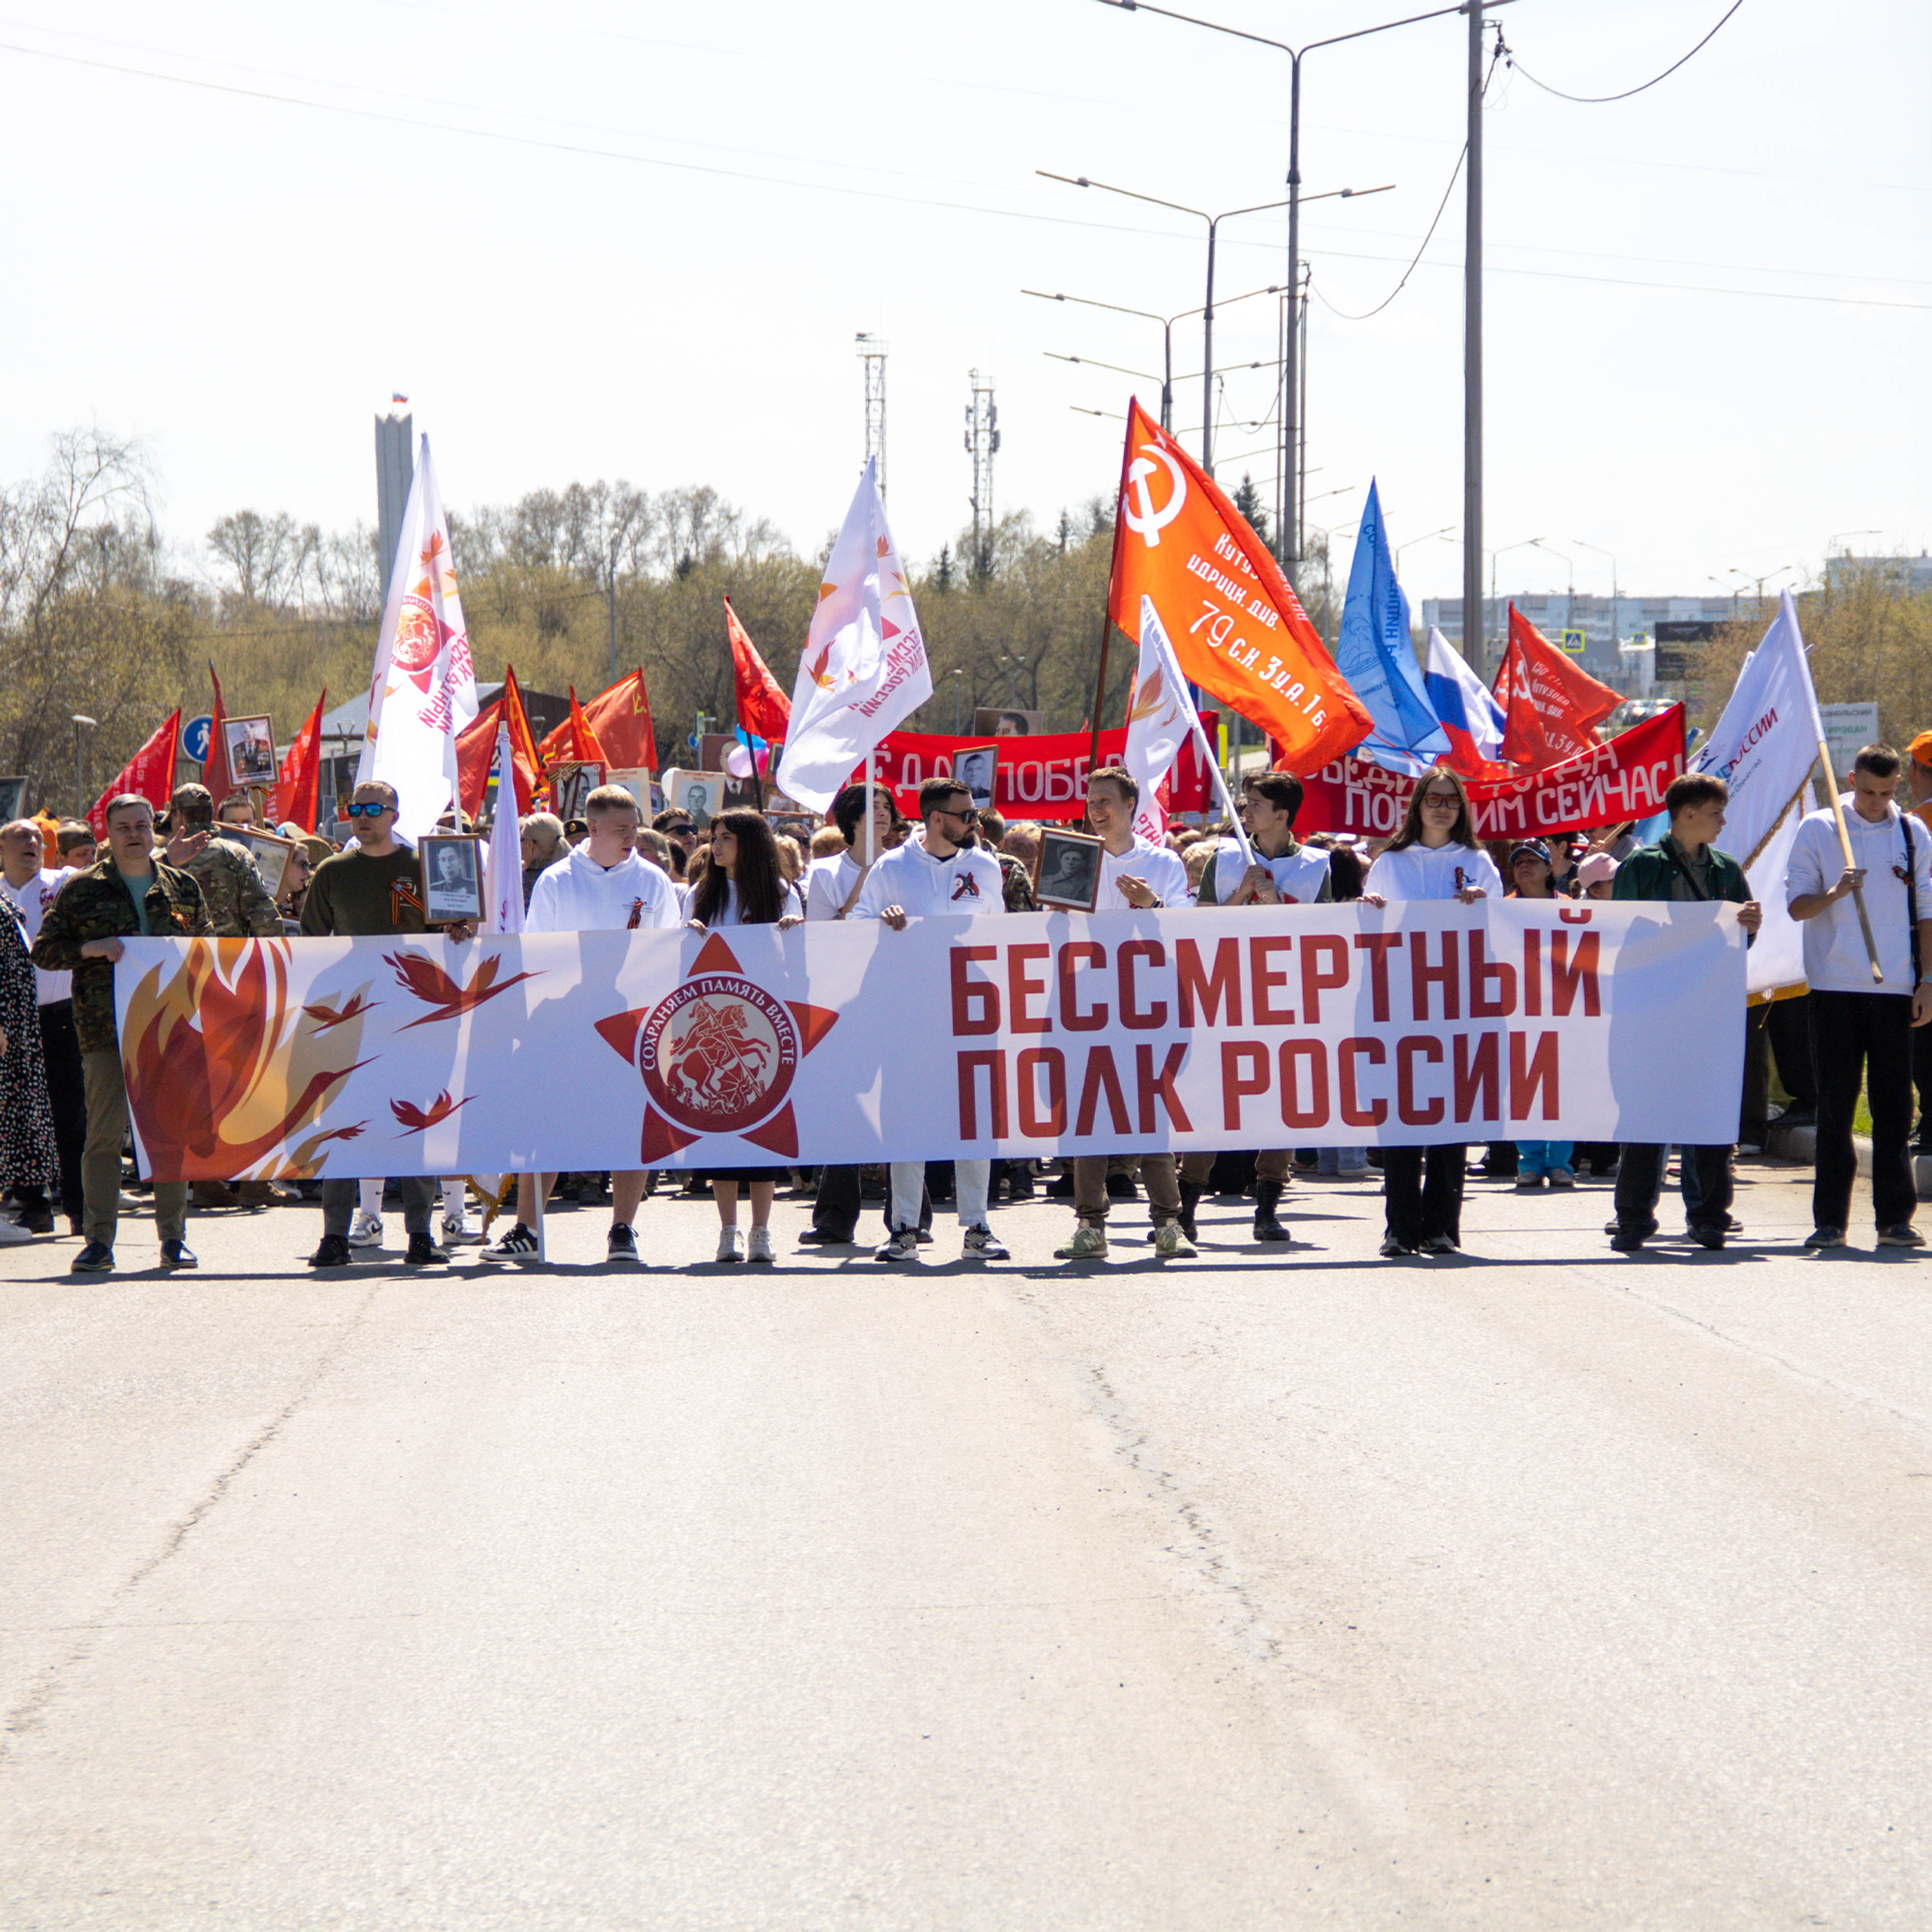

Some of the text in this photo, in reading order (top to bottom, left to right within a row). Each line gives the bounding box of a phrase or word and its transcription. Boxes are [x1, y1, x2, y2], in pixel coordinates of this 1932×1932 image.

[1189, 599, 1235, 648] 79
[1303, 694, 1321, 715] 1
[1820, 707, 1873, 717] СОМОЛЬСКИЙ
[1823, 724, 1868, 734] ТИРОВАН
[949, 908, 1601, 1037] БЕССМЕРТНЫЙ
[643, 980, 794, 1071] СОХРАНЯЕМ ПАМЯТЬ ВМЕСТЕ
[957, 1031, 1560, 1141] ПОЛК РОССИИ
